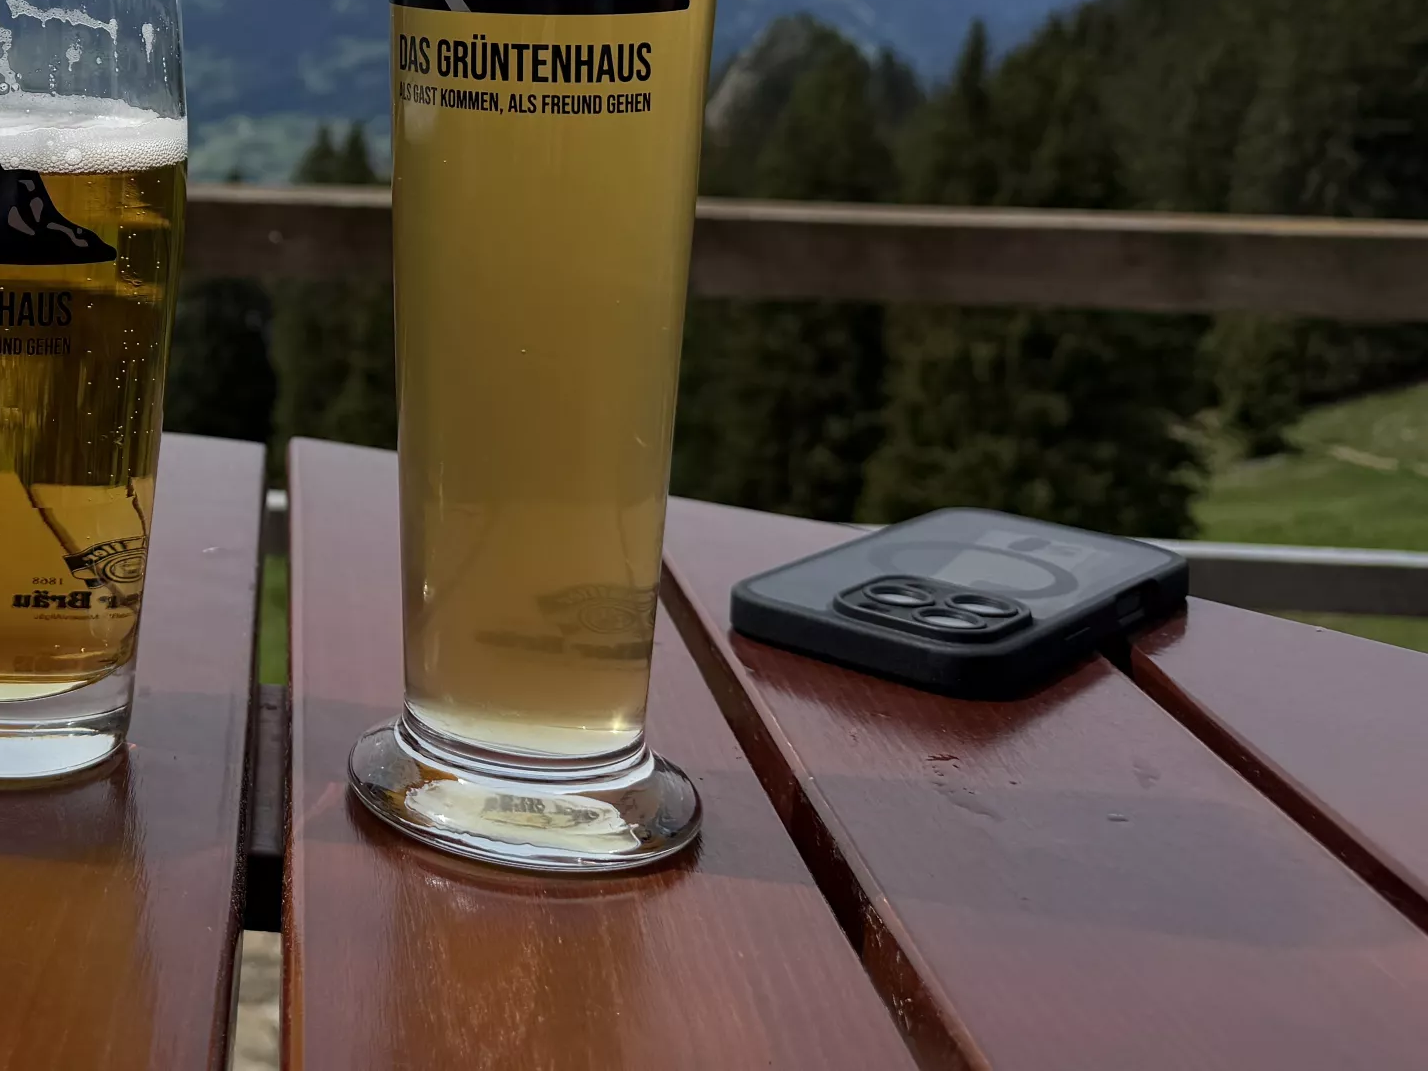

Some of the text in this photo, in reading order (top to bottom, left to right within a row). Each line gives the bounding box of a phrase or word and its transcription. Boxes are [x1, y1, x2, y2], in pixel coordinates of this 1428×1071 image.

[399, 33, 652, 83] DAS GRÜNTENHAUS
[413, 84, 438, 106] GAST
[440, 88, 503, 115] KOMMEN,
[507, 93, 537, 114] ALS
[541, 94, 602, 115] FREUND
[606, 92, 652, 114] GEHEN
[26, 335, 71, 355] GEHEN
